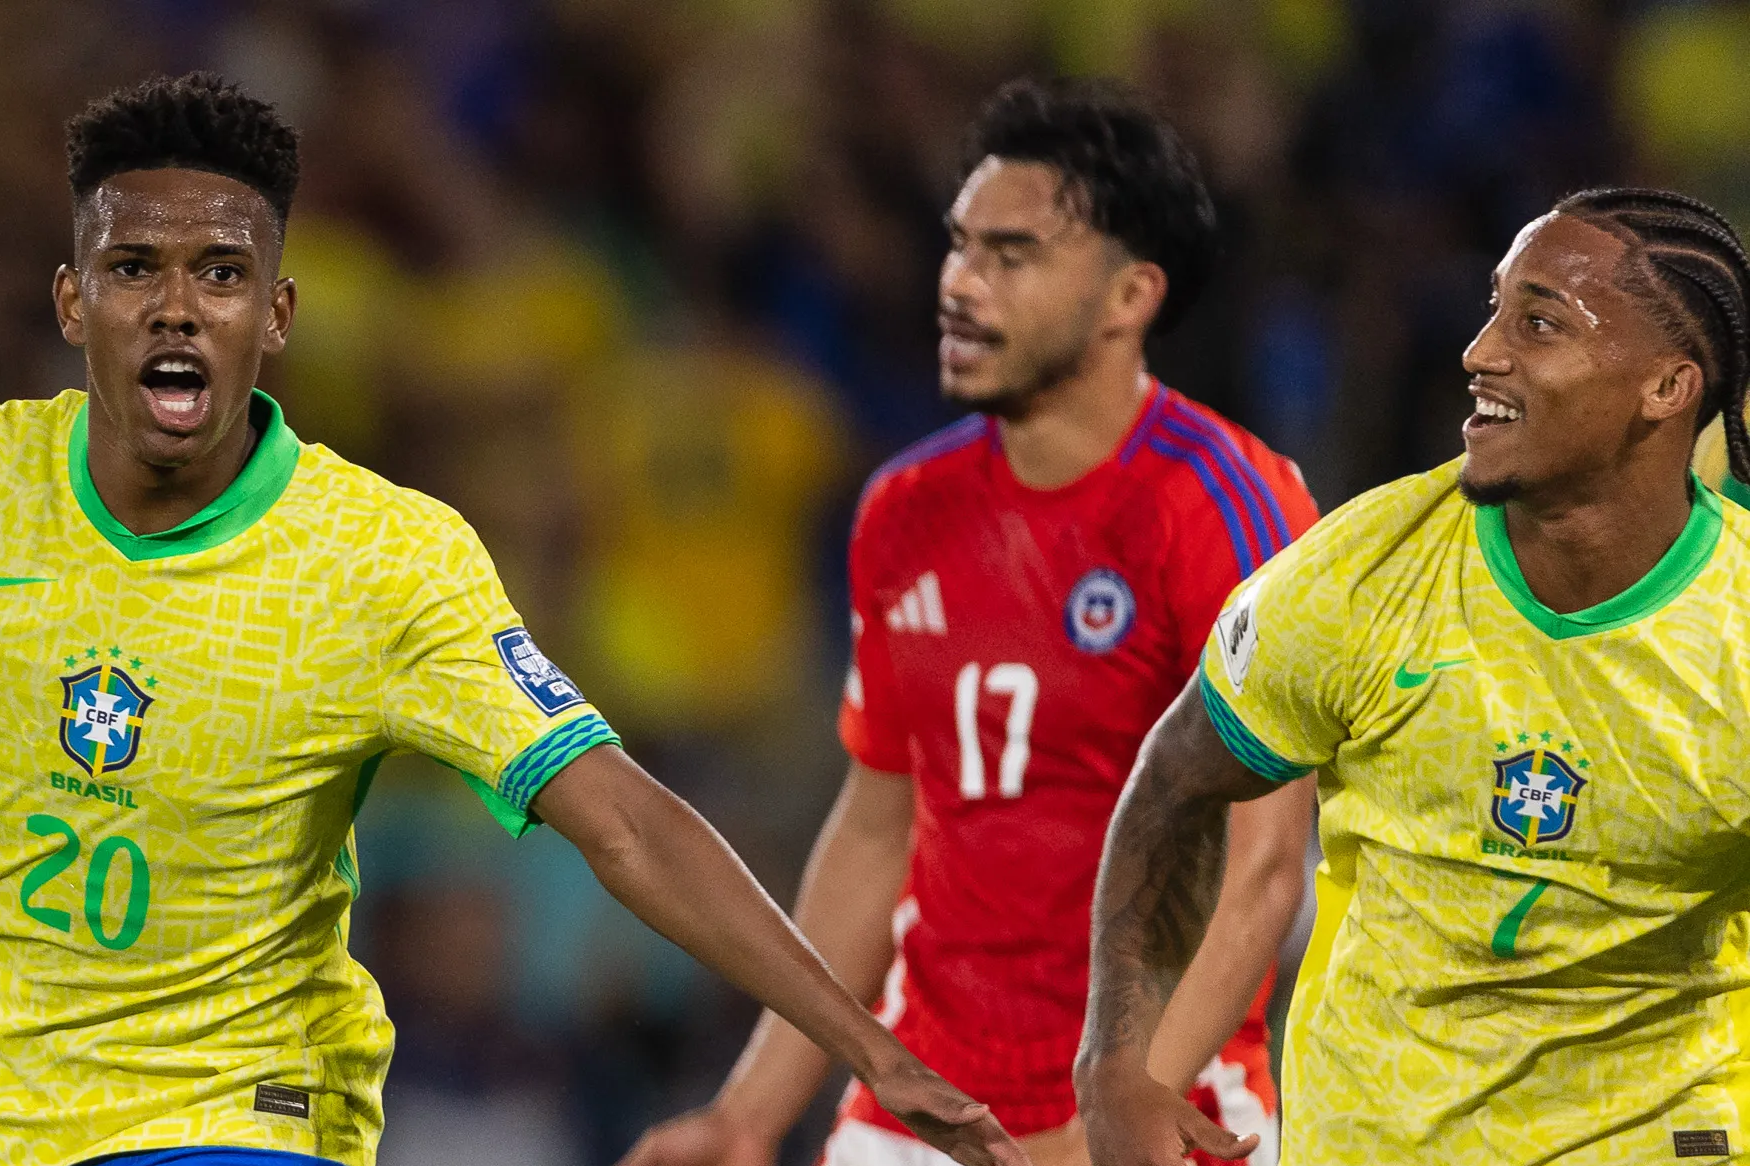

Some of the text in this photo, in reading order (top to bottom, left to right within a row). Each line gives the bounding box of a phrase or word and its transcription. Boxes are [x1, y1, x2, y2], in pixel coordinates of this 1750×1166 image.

[86, 708, 118, 726] CBF
[954, 663, 1038, 798] 17
[51, 771, 138, 809] BRASIL
[1519, 787, 1553, 802] CBF
[1482, 839, 1572, 861] BRASIL
[21, 814, 149, 951] 20
[1490, 868, 1552, 958] 7
